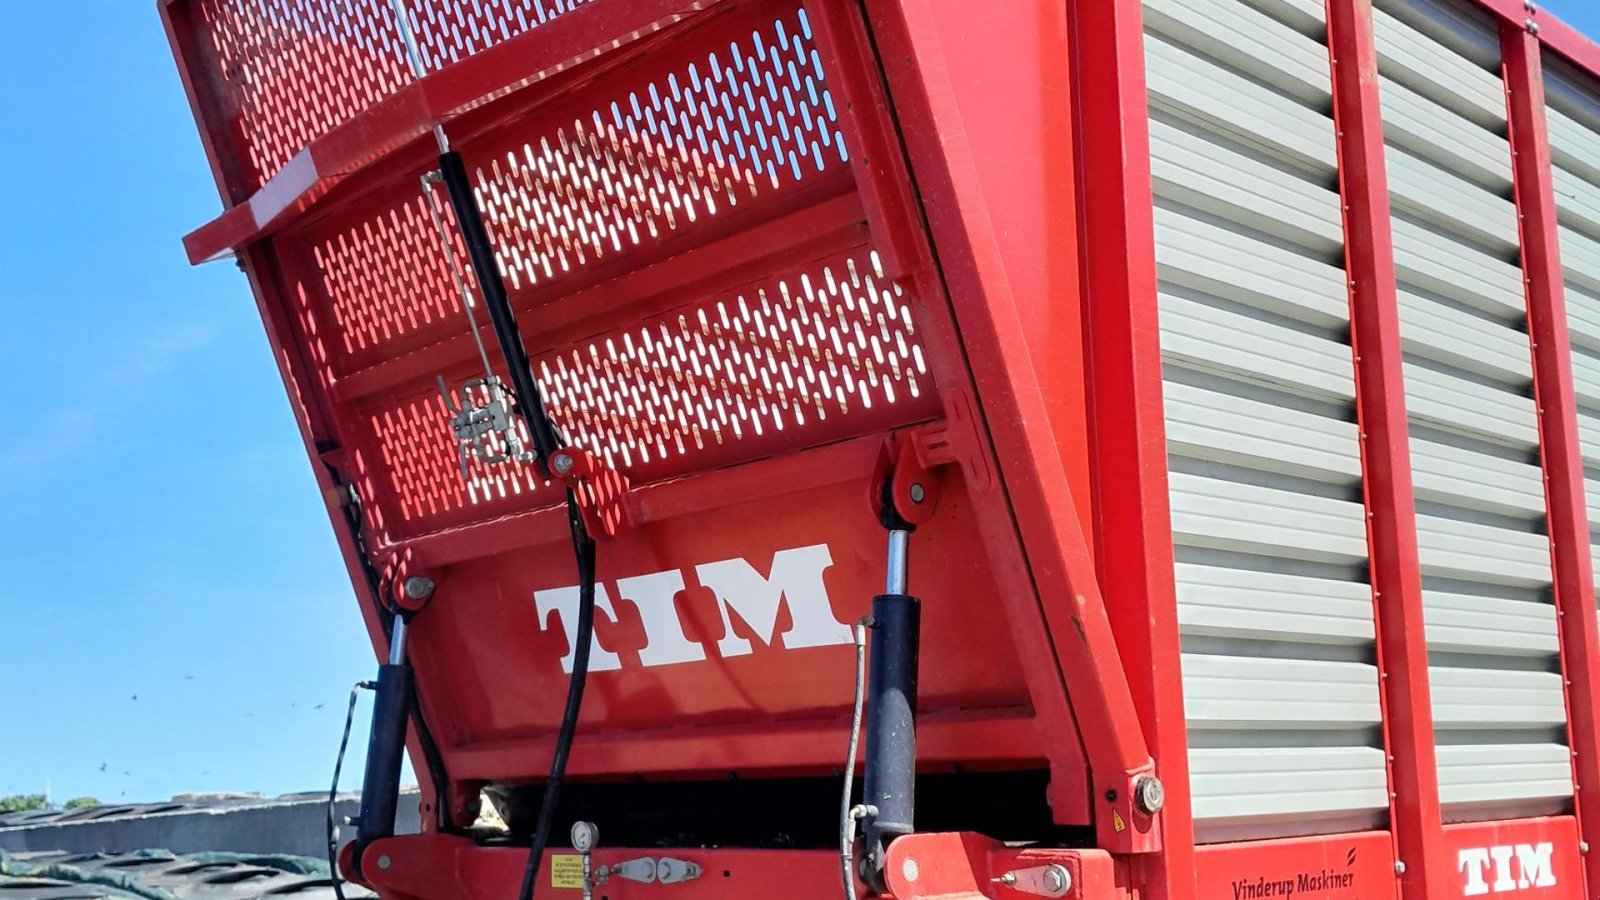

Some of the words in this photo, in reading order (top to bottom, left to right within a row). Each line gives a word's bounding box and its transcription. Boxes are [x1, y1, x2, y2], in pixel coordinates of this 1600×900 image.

[533, 543, 855, 674] TIM
[1232, 877, 1294, 900] Vinderup
[1297, 869, 1354, 893] Maskiner
[1458, 841, 1556, 896] TIM
